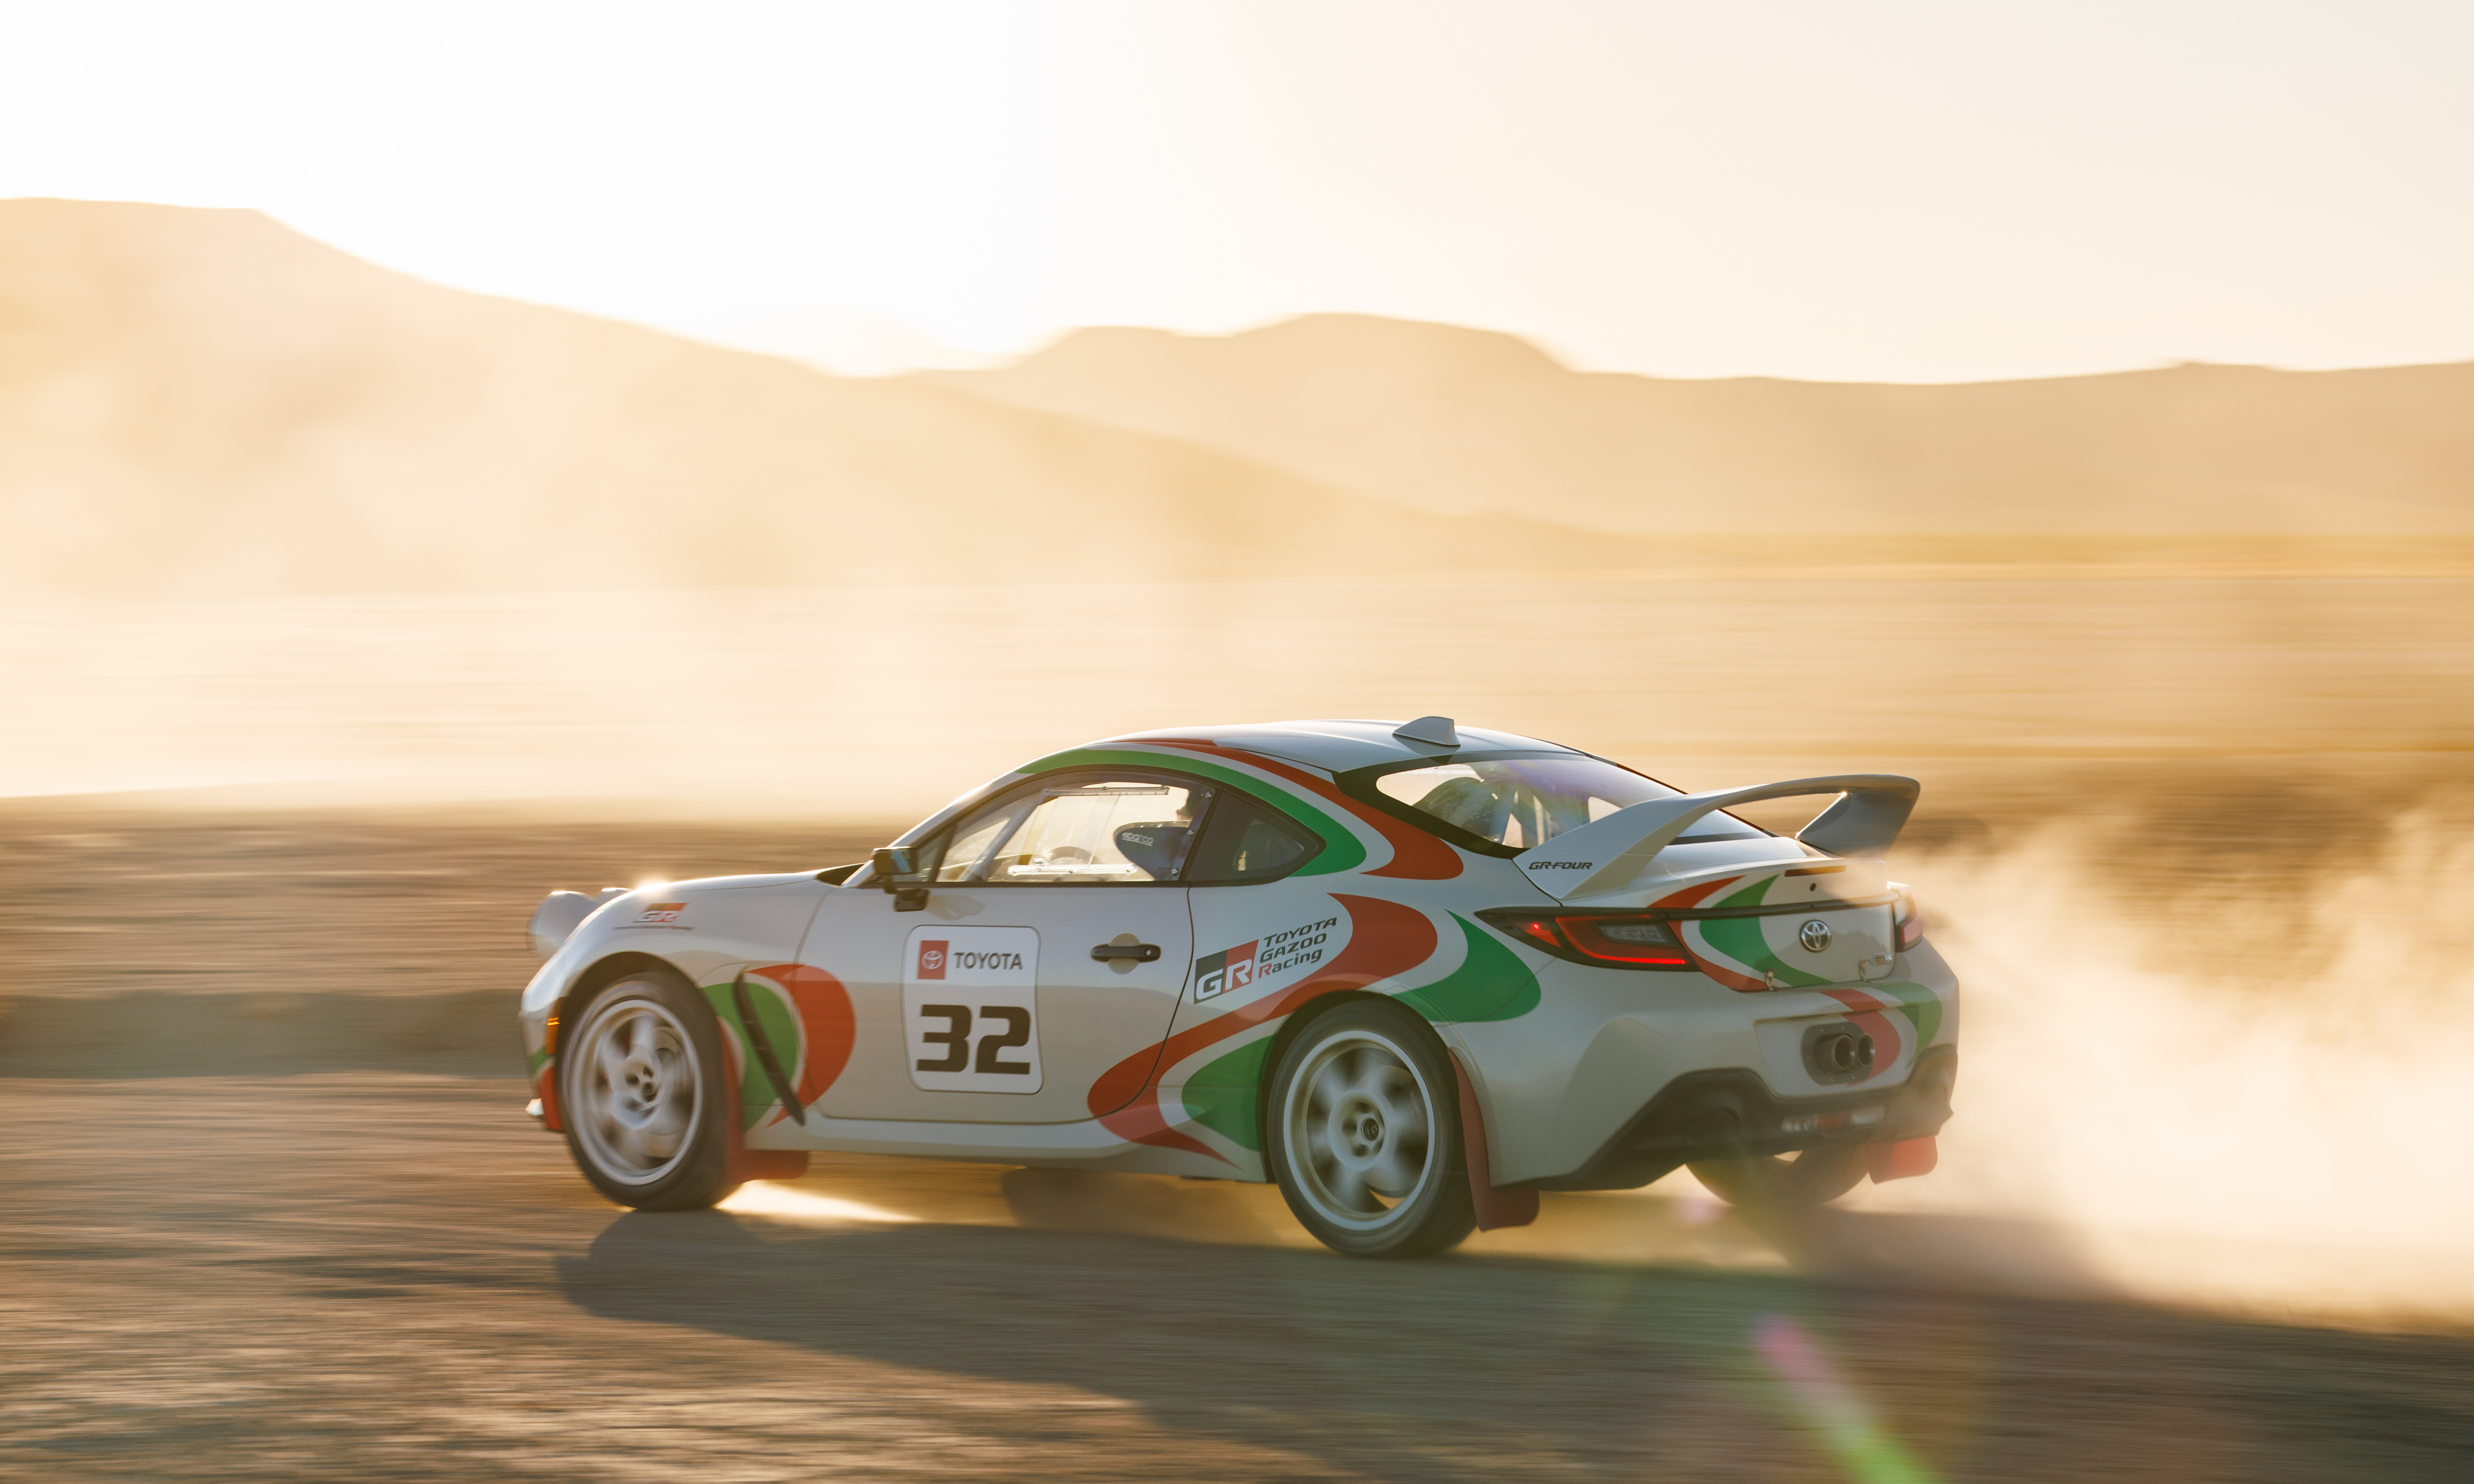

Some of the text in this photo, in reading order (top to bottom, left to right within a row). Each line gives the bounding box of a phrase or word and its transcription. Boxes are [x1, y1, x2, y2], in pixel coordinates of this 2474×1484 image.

[1121, 832, 1154, 845] sparco
[1528, 861, 1593, 870] GR-FOUR
[637, 910, 680, 922] GR
[1260, 932, 1327, 963] GAZOO
[1264, 917, 1337, 948] TOYOTA
[954, 952, 1024, 970] TOYOTA
[1258, 949, 1323, 979] Racing
[1196, 958, 1252, 1000] GR
[915, 1004, 1032, 1075] 32
